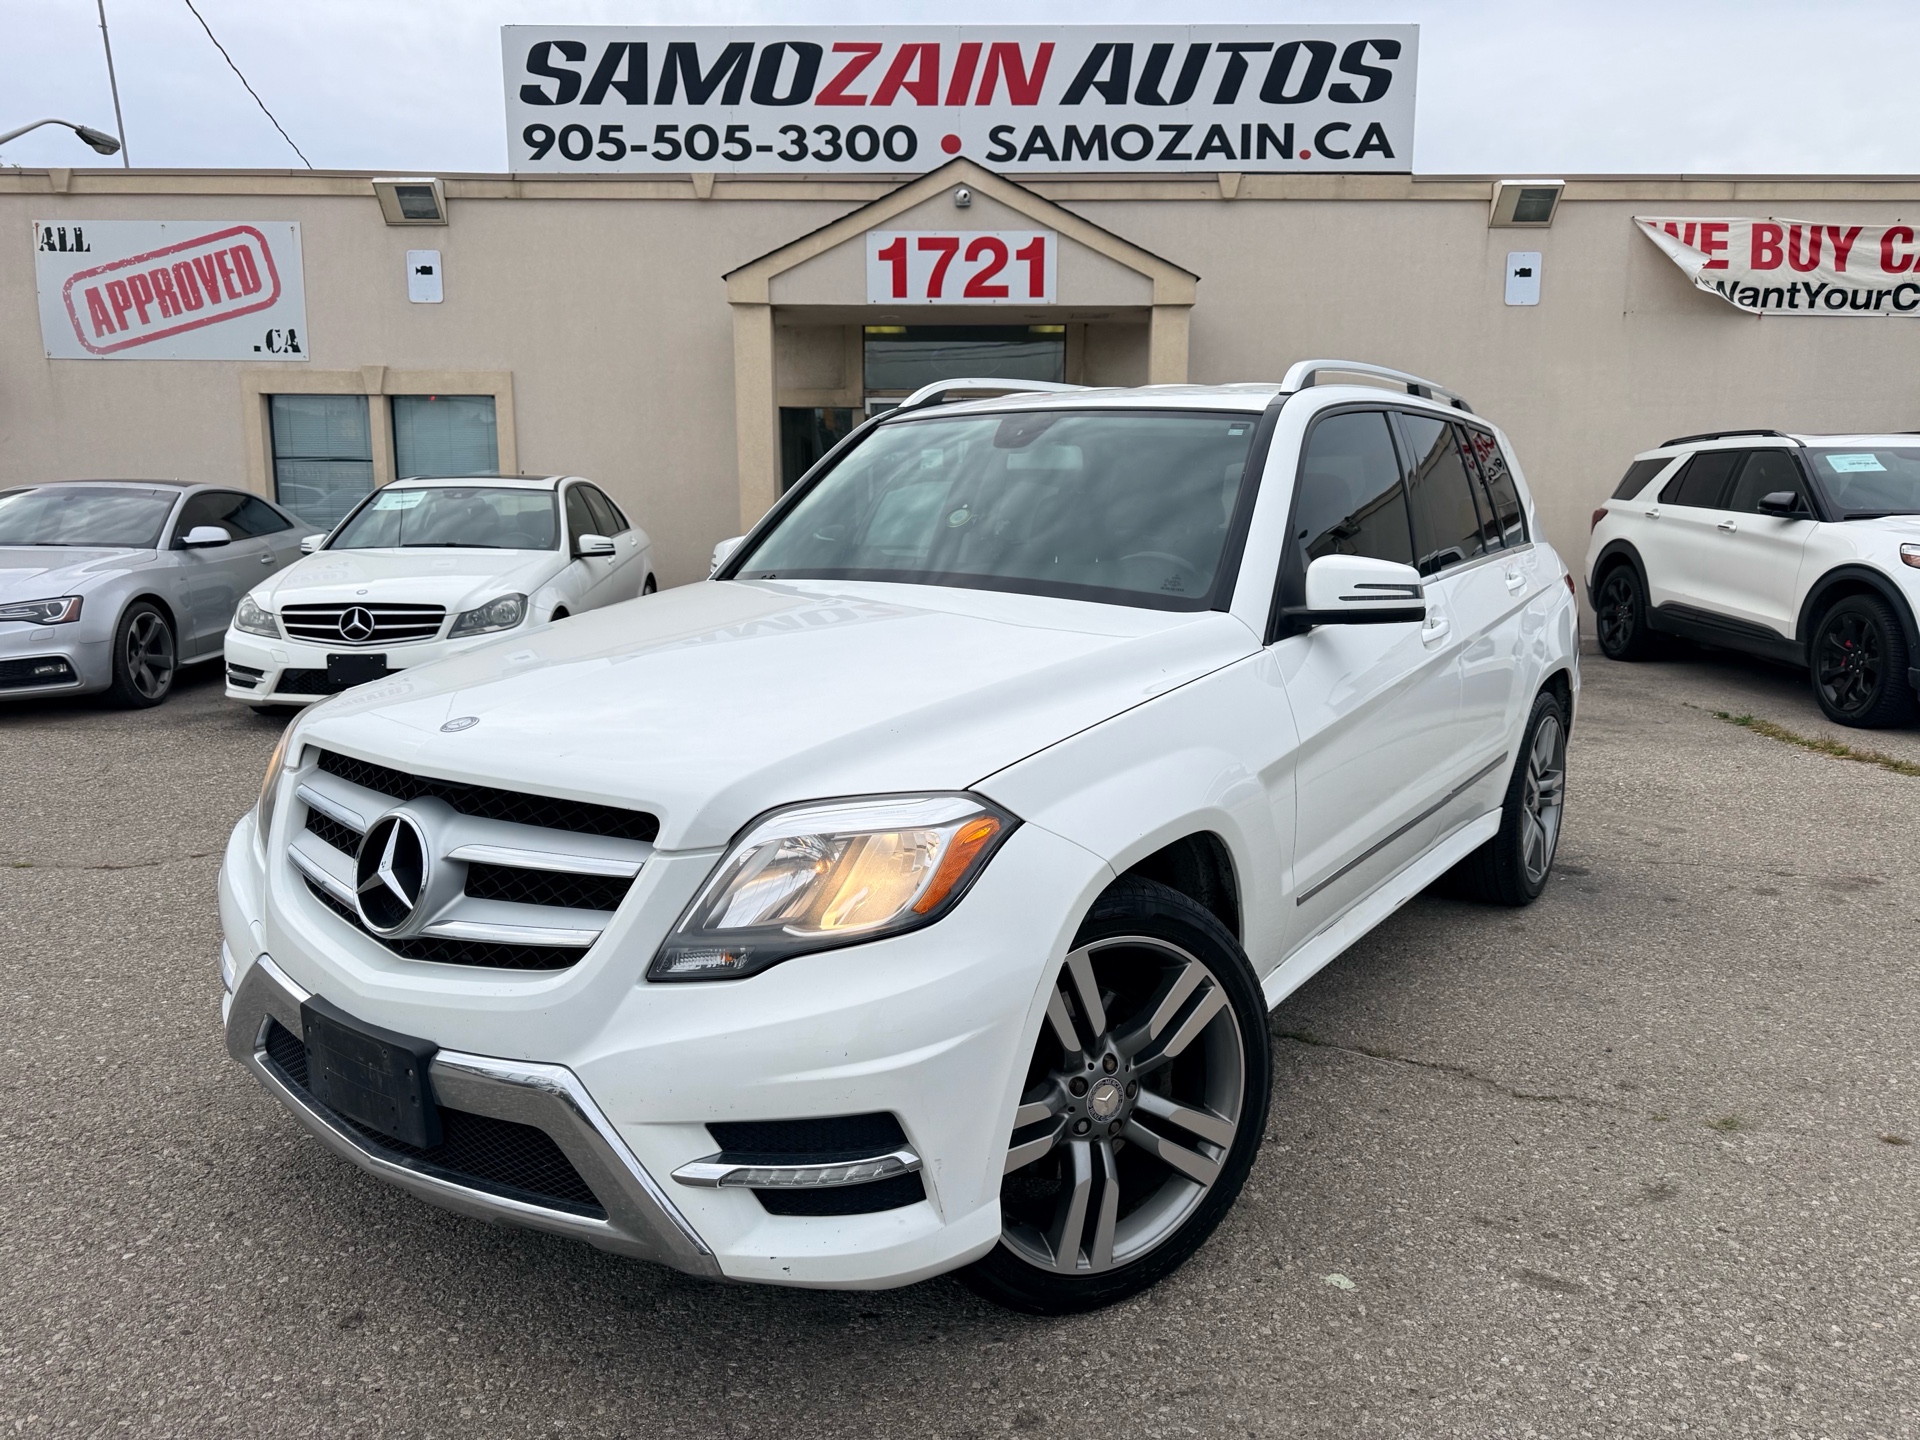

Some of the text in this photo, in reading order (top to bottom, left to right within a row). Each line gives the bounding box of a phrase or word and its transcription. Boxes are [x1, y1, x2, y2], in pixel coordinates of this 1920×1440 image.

[519, 39, 1402, 107] SAMOZAIN AUTOS
[522, 121, 1396, 163] 905-505-3300 SAMOZAIN.CA
[39, 226, 91, 253] ALL
[1750, 222, 1863, 273] BUY
[1879, 225, 1920, 274] C
[84, 244, 262, 338] APPROVED
[877, 235, 1046, 299] 1721
[253, 328, 302, 354] .CA
